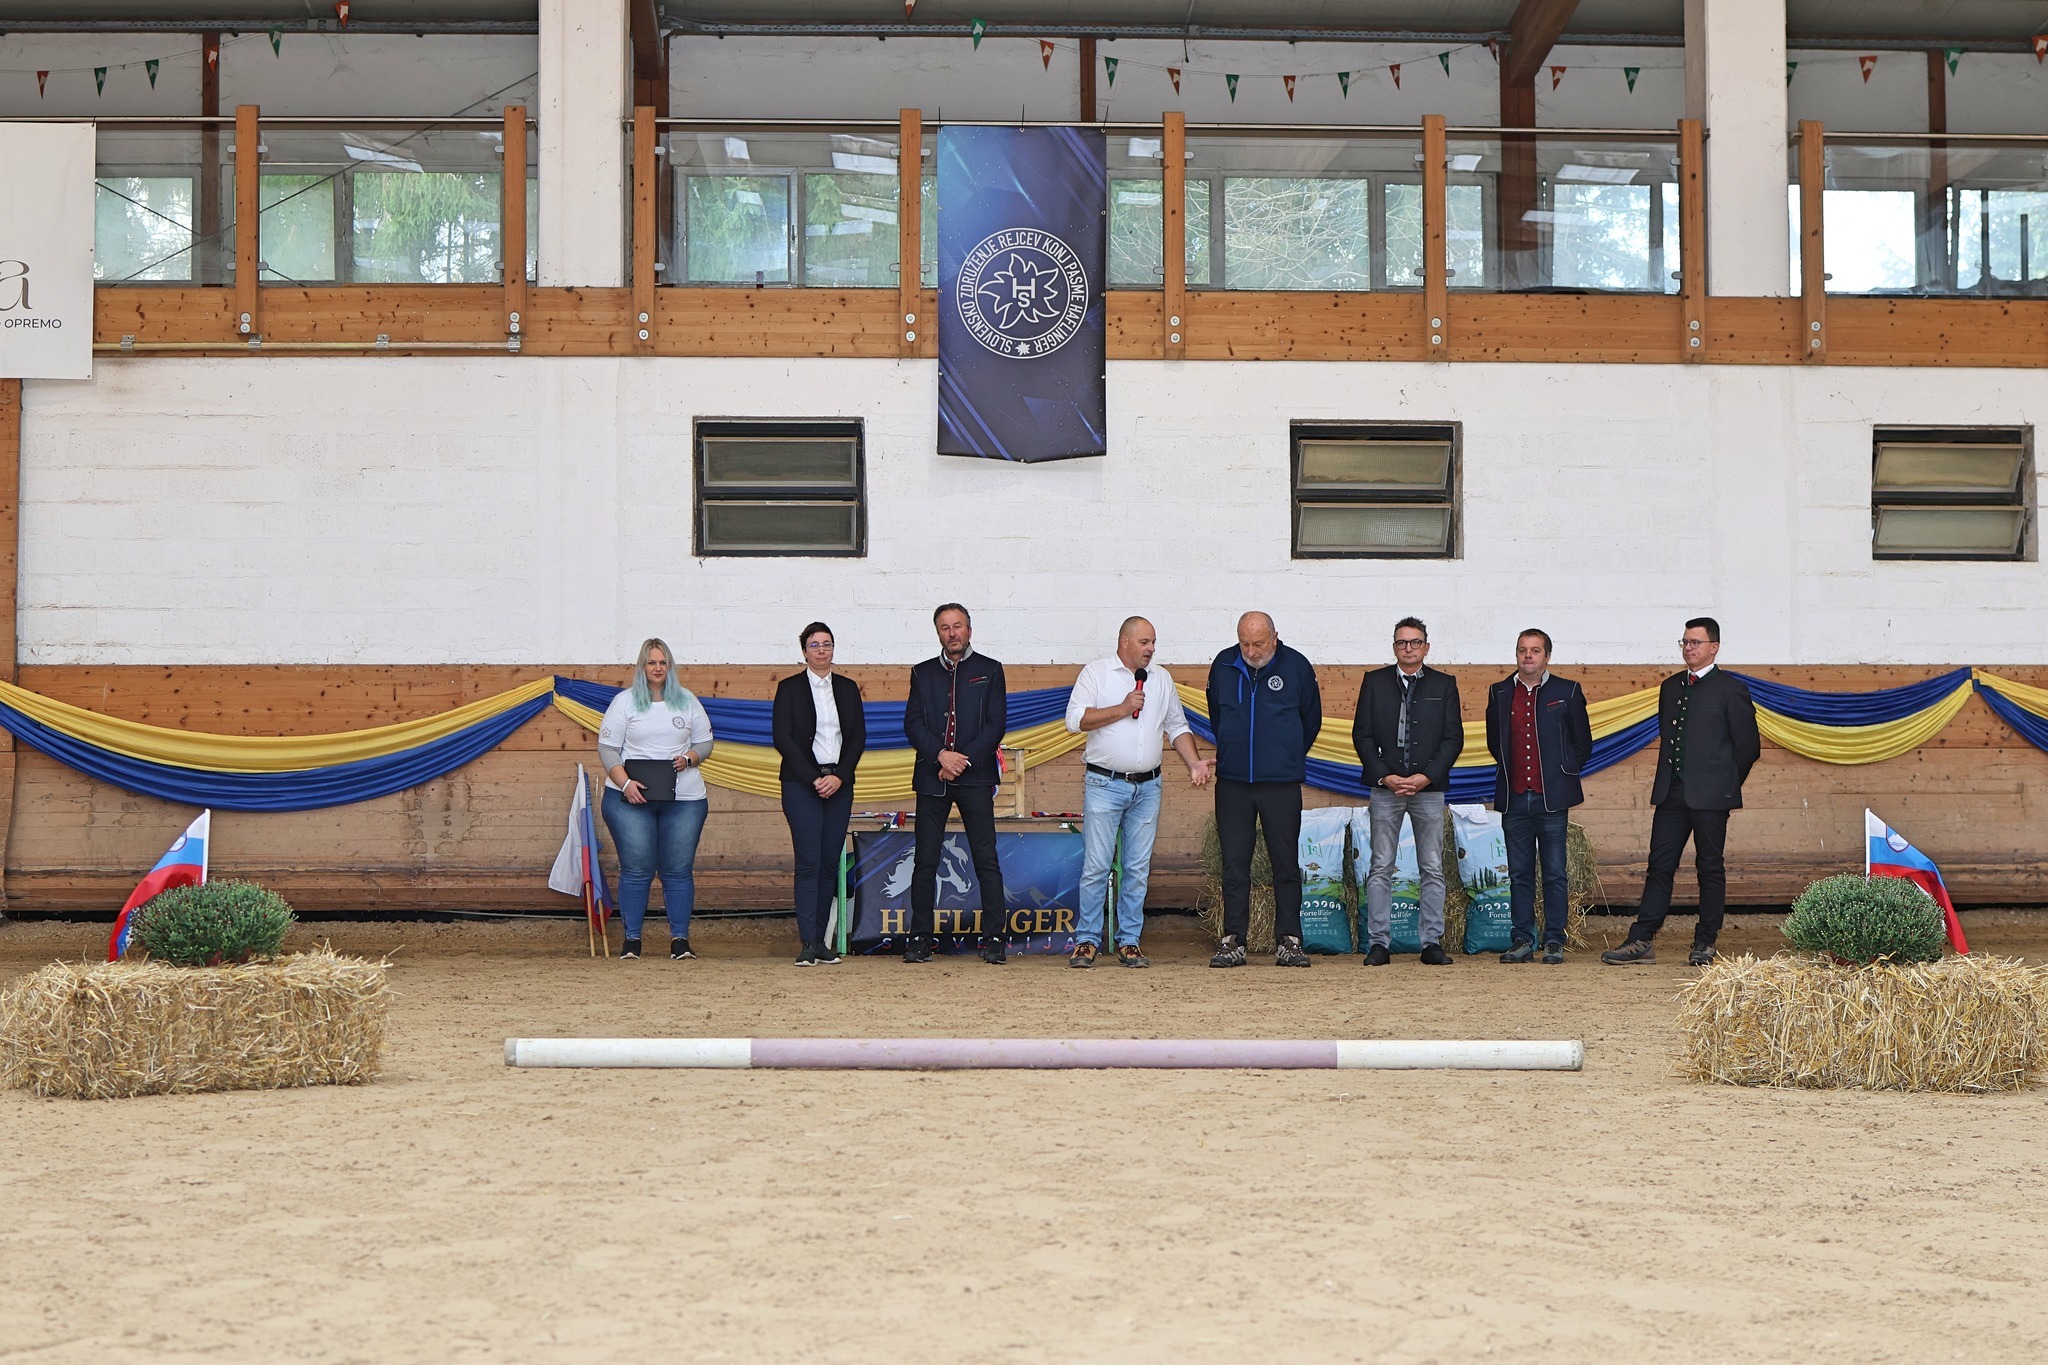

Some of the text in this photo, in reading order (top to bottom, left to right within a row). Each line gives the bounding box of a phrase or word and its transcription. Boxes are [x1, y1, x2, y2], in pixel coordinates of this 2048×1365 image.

[960, 231, 1085, 353] SLOVENSKO ZDRUŽENJE REJCEV KONJ PASME HAFLINGER
[4, 318, 62, 329] OPREMO
[880, 908, 1076, 934] HFLIGER
